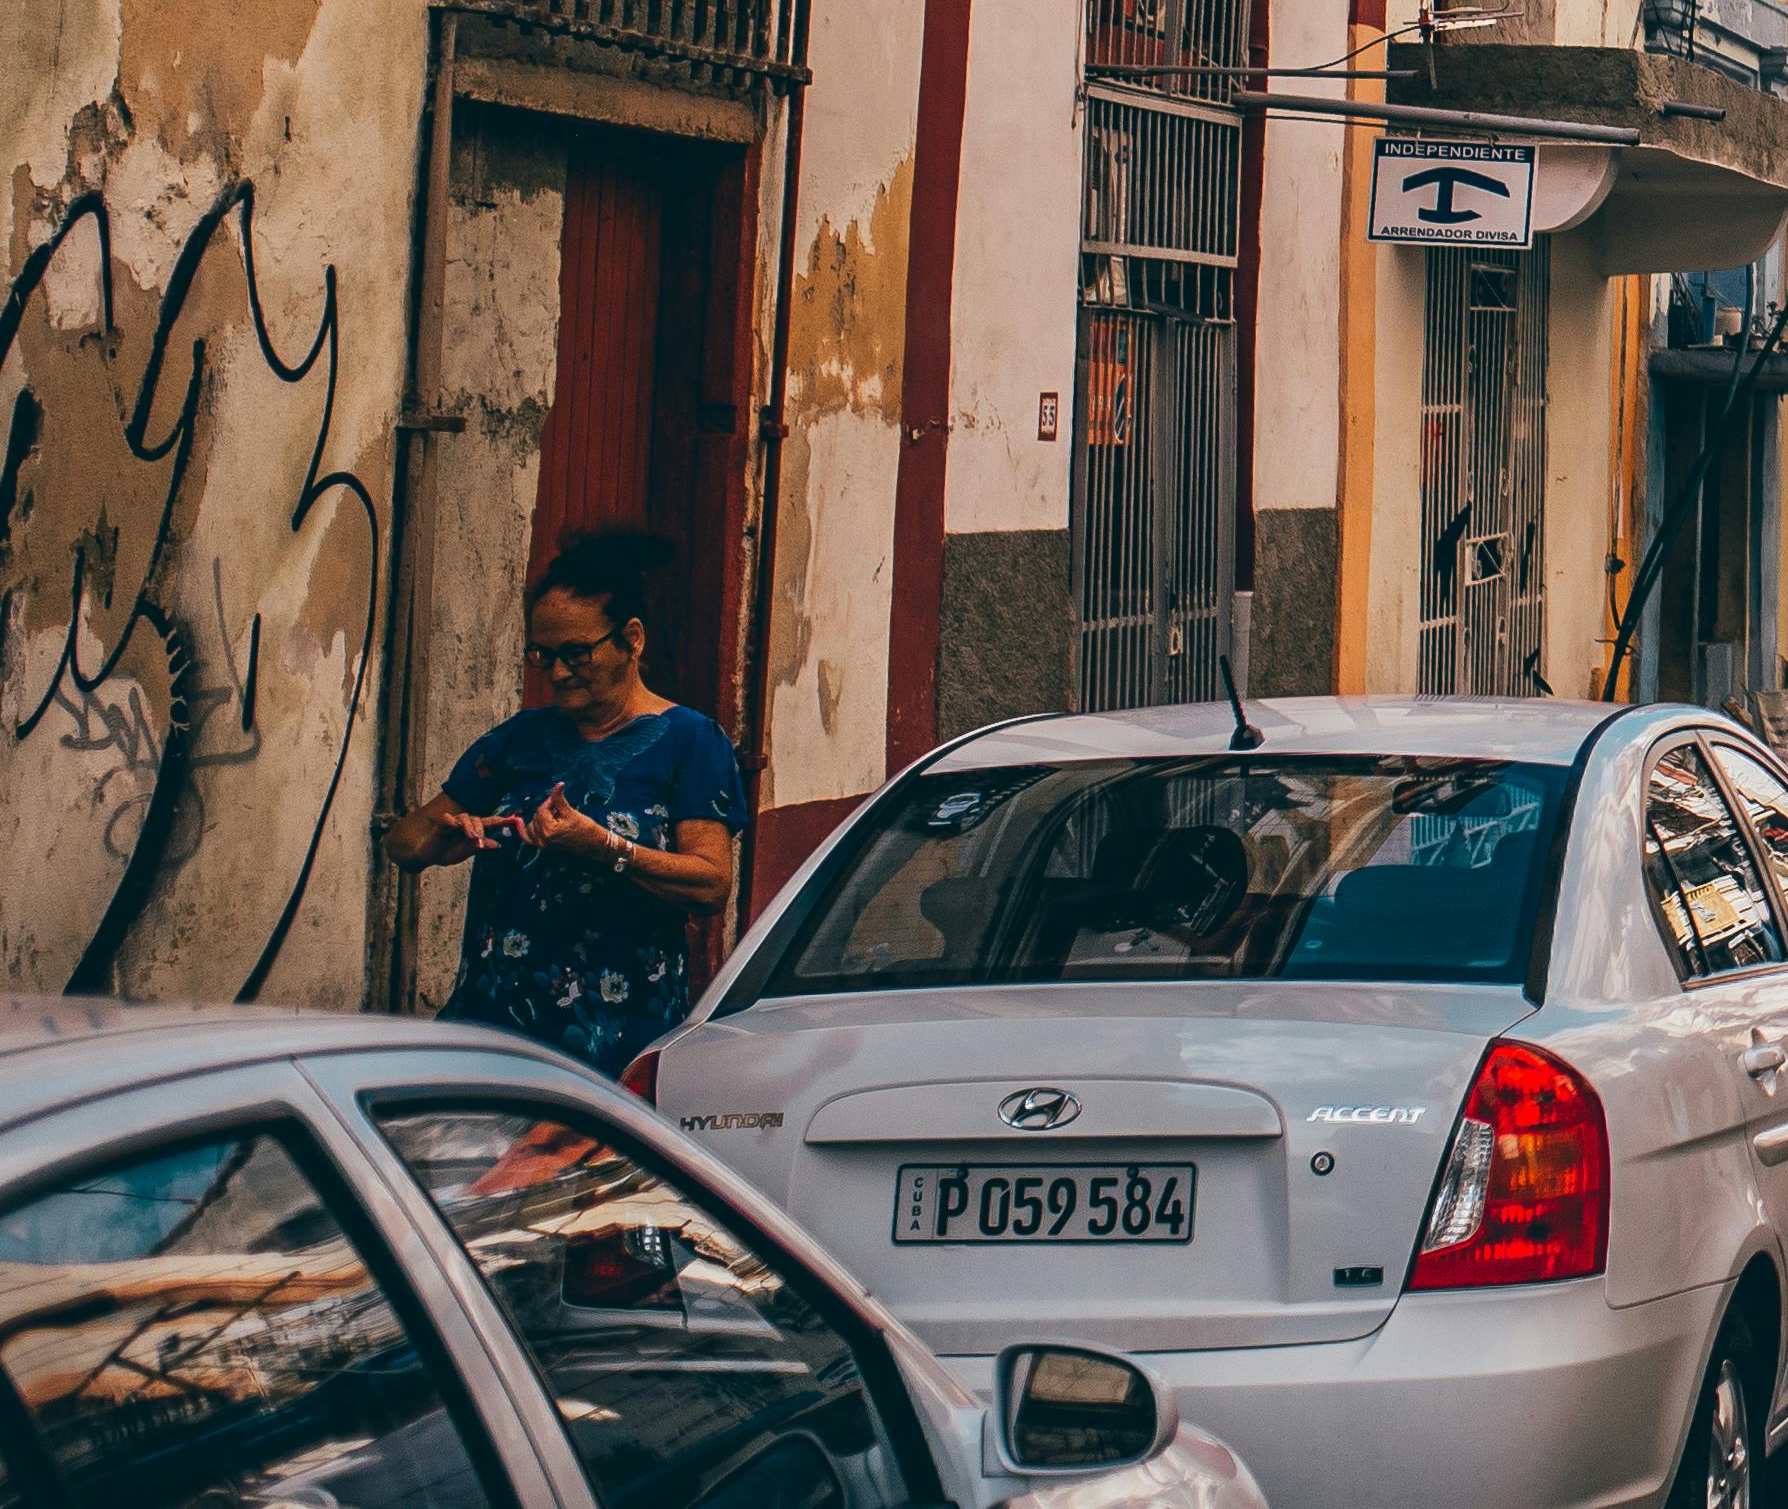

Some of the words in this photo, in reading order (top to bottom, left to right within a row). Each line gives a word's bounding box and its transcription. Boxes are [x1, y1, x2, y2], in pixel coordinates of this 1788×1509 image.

[1384, 142, 1526, 161] INDEPENDIENTE
[1380, 225, 1473, 240] ARRENDADOR
[1475, 229, 1518, 241] DIVISA
[680, 1112, 784, 1131] HYUNDAI
[1306, 1105, 1427, 1125] ACCENT
[910, 1176, 925, 1232] CUBA
[936, 1177, 969, 1237] P
[978, 1177, 1078, 1237] 059
[1087, 1176, 1185, 1236] 584
